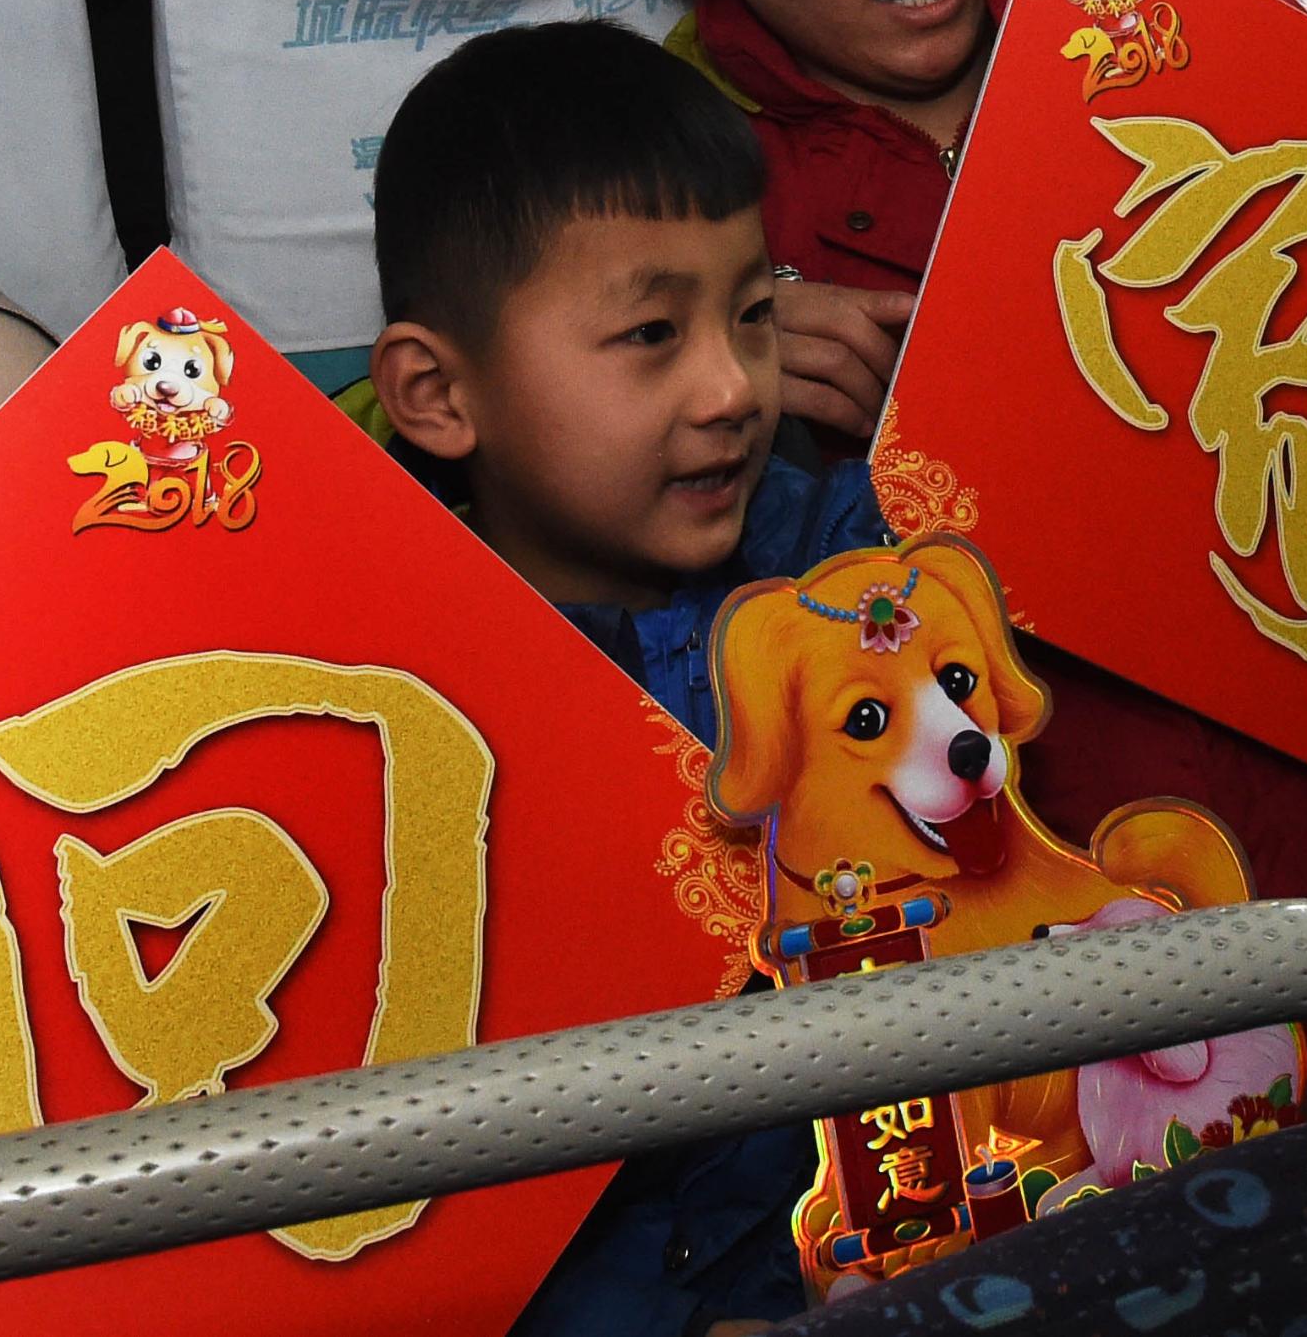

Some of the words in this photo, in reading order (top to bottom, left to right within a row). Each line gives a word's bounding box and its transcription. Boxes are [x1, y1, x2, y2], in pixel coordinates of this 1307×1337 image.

[1060, 1, 1190, 104] 2018
[67, 440, 262, 536] 2018
[860, 1097, 950, 1215] 如意
